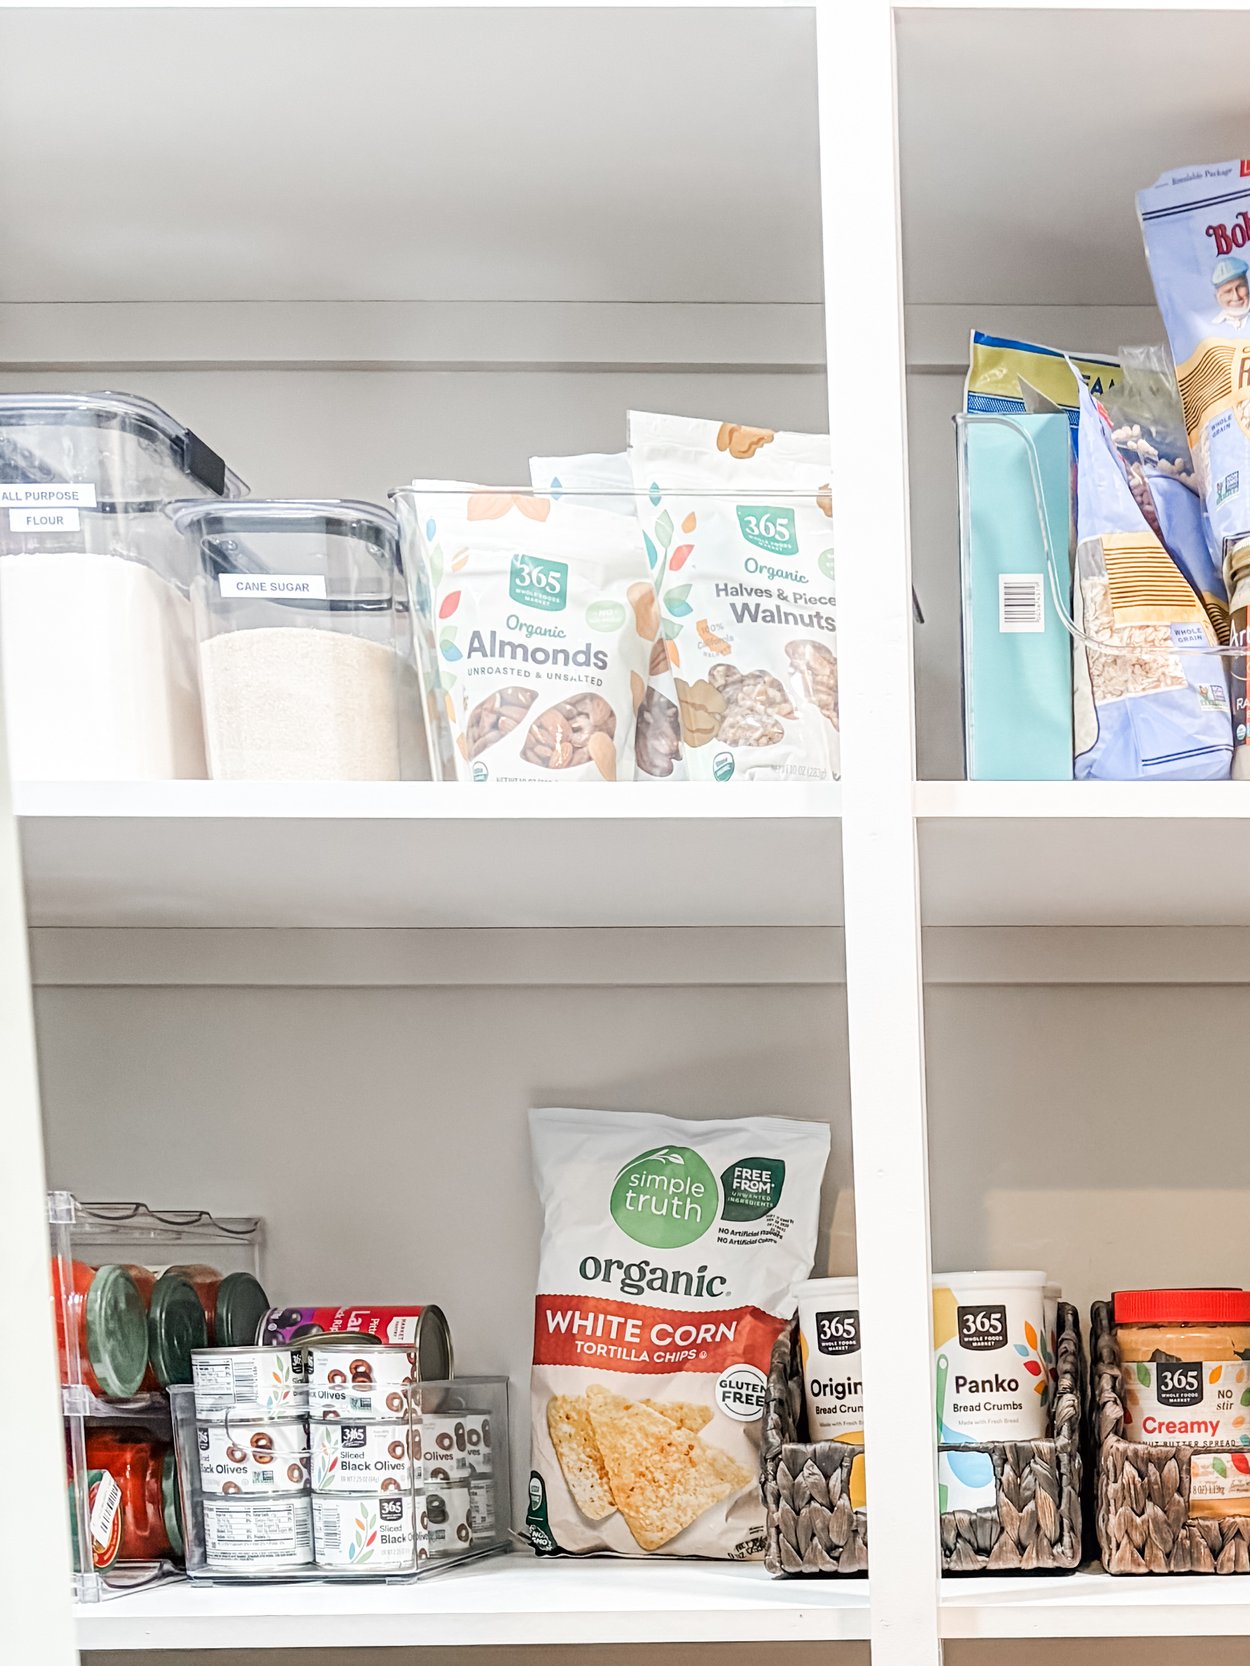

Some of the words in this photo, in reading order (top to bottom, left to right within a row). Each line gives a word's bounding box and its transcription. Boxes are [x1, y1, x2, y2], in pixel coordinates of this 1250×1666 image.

[1210, 415, 1233, 431] WHOLE
[2, 491, 22, 501] ALL
[24, 490, 79, 502] PURPOSE
[26, 515, 64, 526] FLOUR
[743, 514, 790, 541] 365
[514, 560, 561, 594] 365
[744, 557, 810, 585] Organic
[236, 581, 266, 592] CANE
[269, 582, 310, 593] SUGAR
[715, 583, 773, 600] Halves
[729, 602, 837, 633] Walnuts
[506, 614, 567, 640] Organic
[1173, 627, 1203, 638] WHOLE
[1177, 633, 1203, 643] GRAIN
[467, 630, 609, 672] Almonds
[467, 667, 531, 681] UNROASTED
[546, 674, 604, 688] UNSALTED
[734, 1167, 772, 1182] FREE
[628, 1170, 705, 1198] simple
[732, 1178, 771, 1194] FROM
[625, 1189, 703, 1223] truth
[718, 1227, 729, 1235] NO
[730, 1229, 760, 1237] Artificial
[716, 1236, 728, 1244] NO
[728, 1237, 758, 1246] Artificial
[578, 1254, 728, 1299] organic
[545, 1308, 644, 1344] WHITE
[650, 1319, 738, 1350] CORN
[819, 1316, 857, 1340] 365
[962, 1311, 1003, 1335] 365
[575, 1340, 650, 1363] TORTILLA
[652, 1348, 698, 1364] CHIPS
[719, 1379, 766, 1395] GLUTEN
[954, 1373, 1020, 1396] Panko
[1160, 1369, 1199, 1392] 365
[317, 1390, 346, 1400] Olives
[721, 1390, 765, 1406] FREE
[1217, 1389, 1233, 1399] NO
[815, 1404, 839, 1415] Bread
[953, 1401, 981, 1413] Bread
[983, 1400, 1023, 1412] Crumbs
[1215, 1400, 1234, 1412] stir
[1142, 1415, 1221, 1438] Creamy
[340, 1451, 365, 1460] Sliced
[423, 1451, 454, 1462] Olives
[215, 1462, 248, 1475] Olives
[340, 1460, 372, 1472] Black
[373, 1460, 406, 1472] Olives
[381, 1500, 402, 1514] 365
[379, 1525, 402, 1533] Sliced
[380, 1533, 406, 1545] Black
